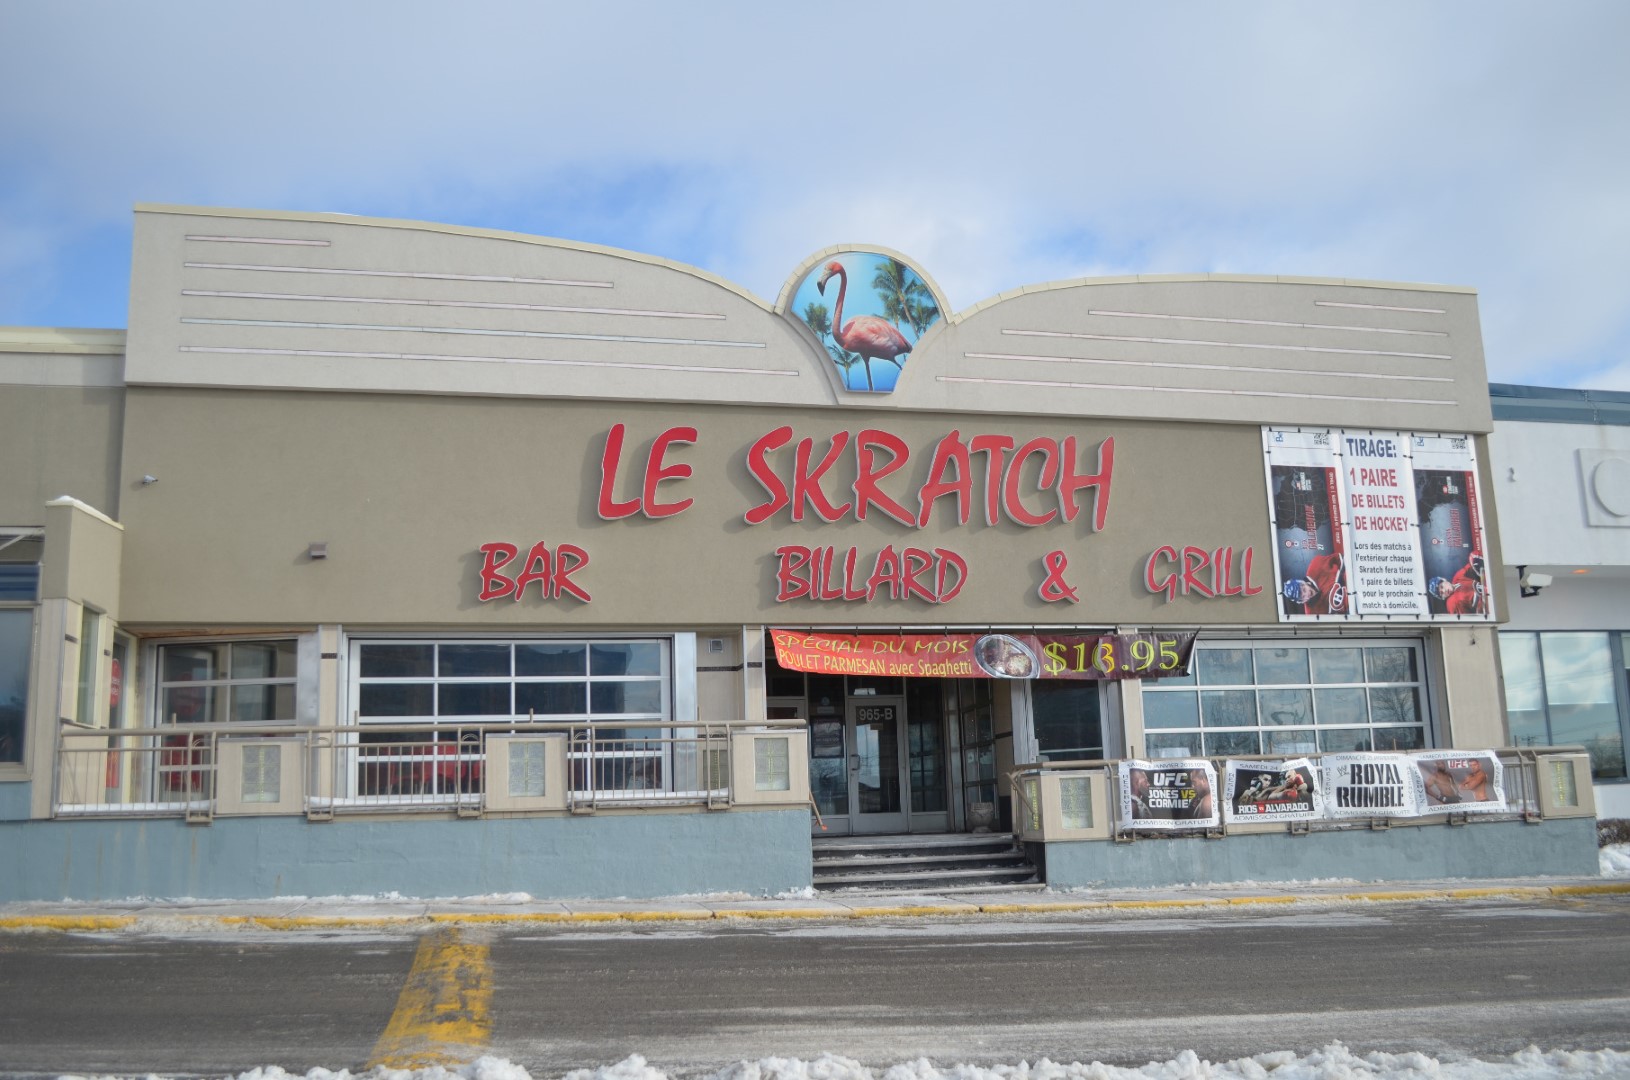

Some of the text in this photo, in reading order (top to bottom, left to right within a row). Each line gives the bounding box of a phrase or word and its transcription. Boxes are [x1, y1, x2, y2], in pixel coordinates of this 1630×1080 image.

[1346, 438, 1397, 458] TIRAGE:
[597, 423, 1116, 532] LE SKRATCH
[1350, 467, 1398, 487] 1 PAIRE
[1351, 494, 1405, 509] DE BILLETS
[1354, 516, 1408, 531] DE HOCKEY
[1354, 542, 1369, 550] Lors
[1370, 542, 1382, 550] des
[1390, 554, 1413, 564] chaque
[478, 540, 1263, 603] BAR BILLARD & GRILL
[1359, 566, 1414, 574] Skratch fera tirer
[1366, 578, 1382, 587] paire
[1384, 578, 1392, 586] de
[1393, 577, 1414, 586] billets
[1378, 589, 1384, 597] le
[1385, 590, 1414, 599] prochain
[1388, 601, 1419, 609] domicile.
[775, 634, 970, 654] SPÉCIAL DU MOIS
[779, 648, 973, 677] POULET PARMESAN avec Spaghetti
[859, 707, 893, 721] 965-B
[1449, 760, 1468, 768] UFC
[1153, 772, 1188, 786] UFC
[1350, 763, 1404, 785] ROYAL
[1148, 789, 1197, 799] JONES VS
[1336, 786, 1404, 808] RUMBLE
[1238, 805, 1258, 814] RIOS
[1265, 802, 1309, 812] ALVARADO
[1428, 803, 1471, 812] ADMISSION
[1233, 813, 1278, 821] ADMISSION
